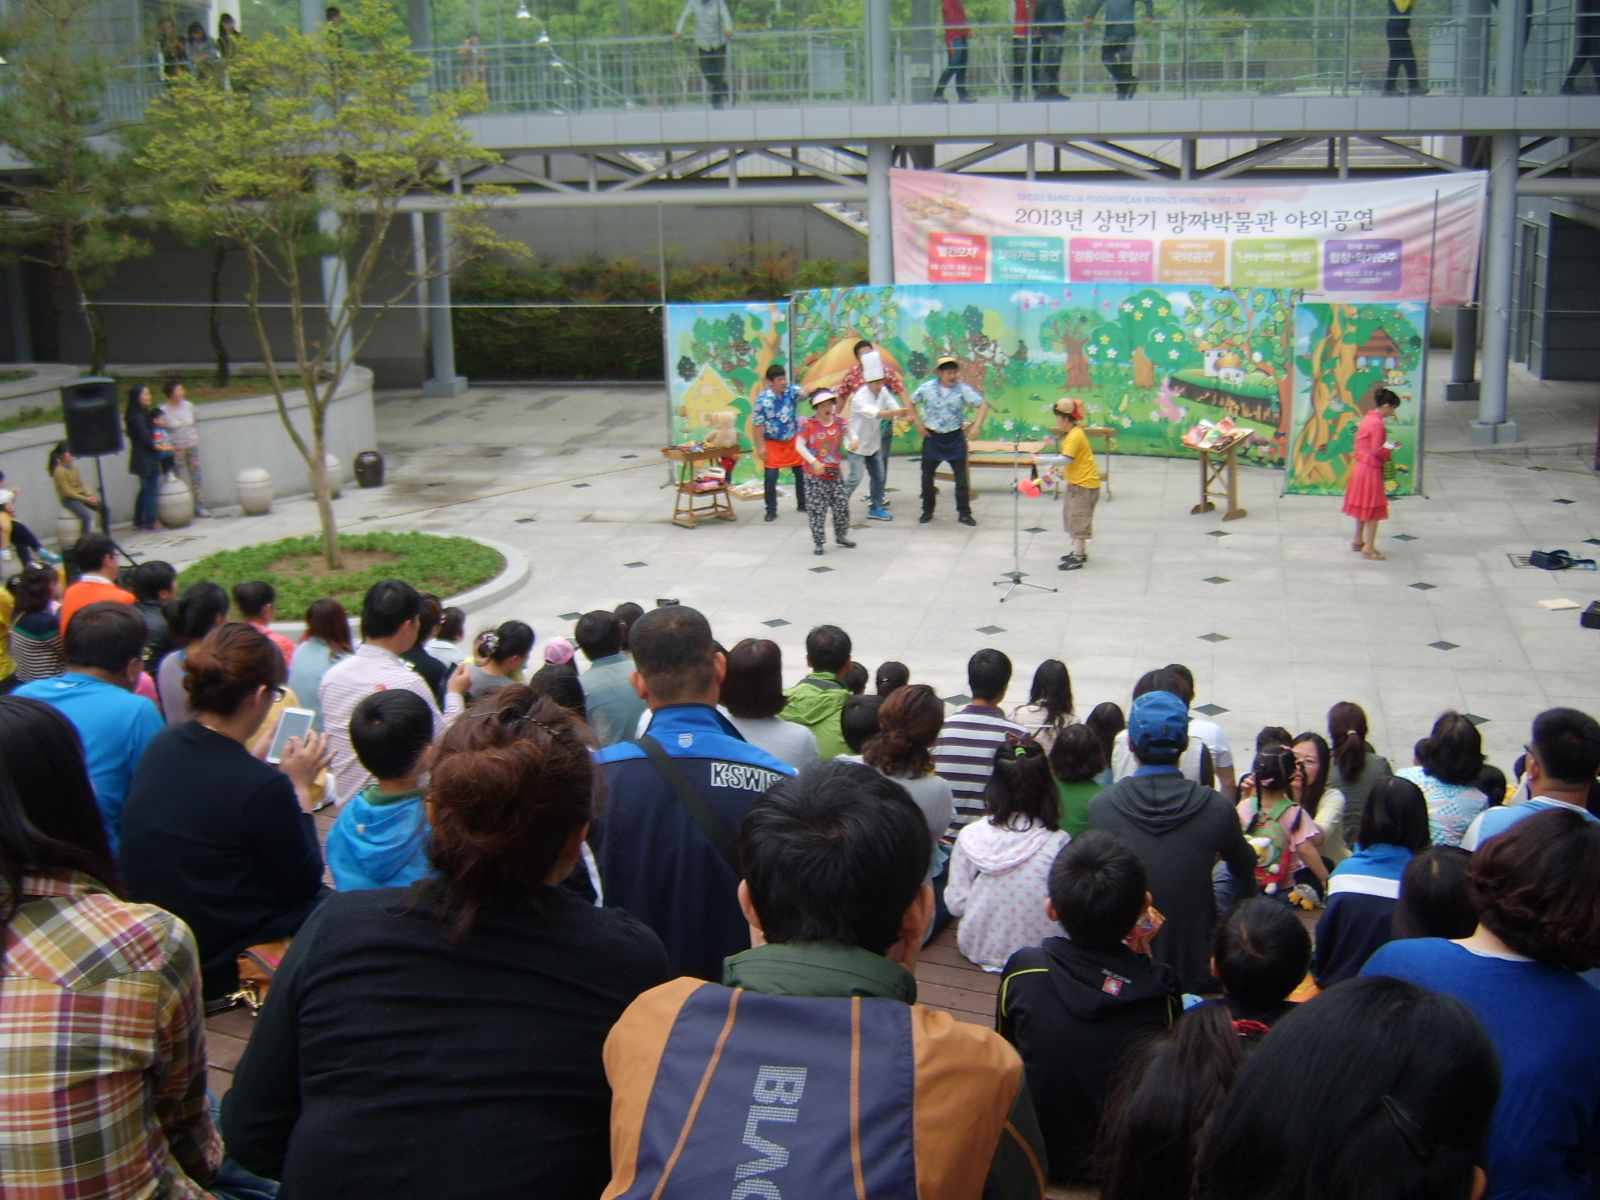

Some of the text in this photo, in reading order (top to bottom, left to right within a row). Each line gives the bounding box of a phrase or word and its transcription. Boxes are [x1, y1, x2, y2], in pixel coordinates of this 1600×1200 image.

[1207, 196, 1246, 205] MUSEUM
[1014, 208, 1374, 234] 2013년 상반기 방짜박물관 야외공연
